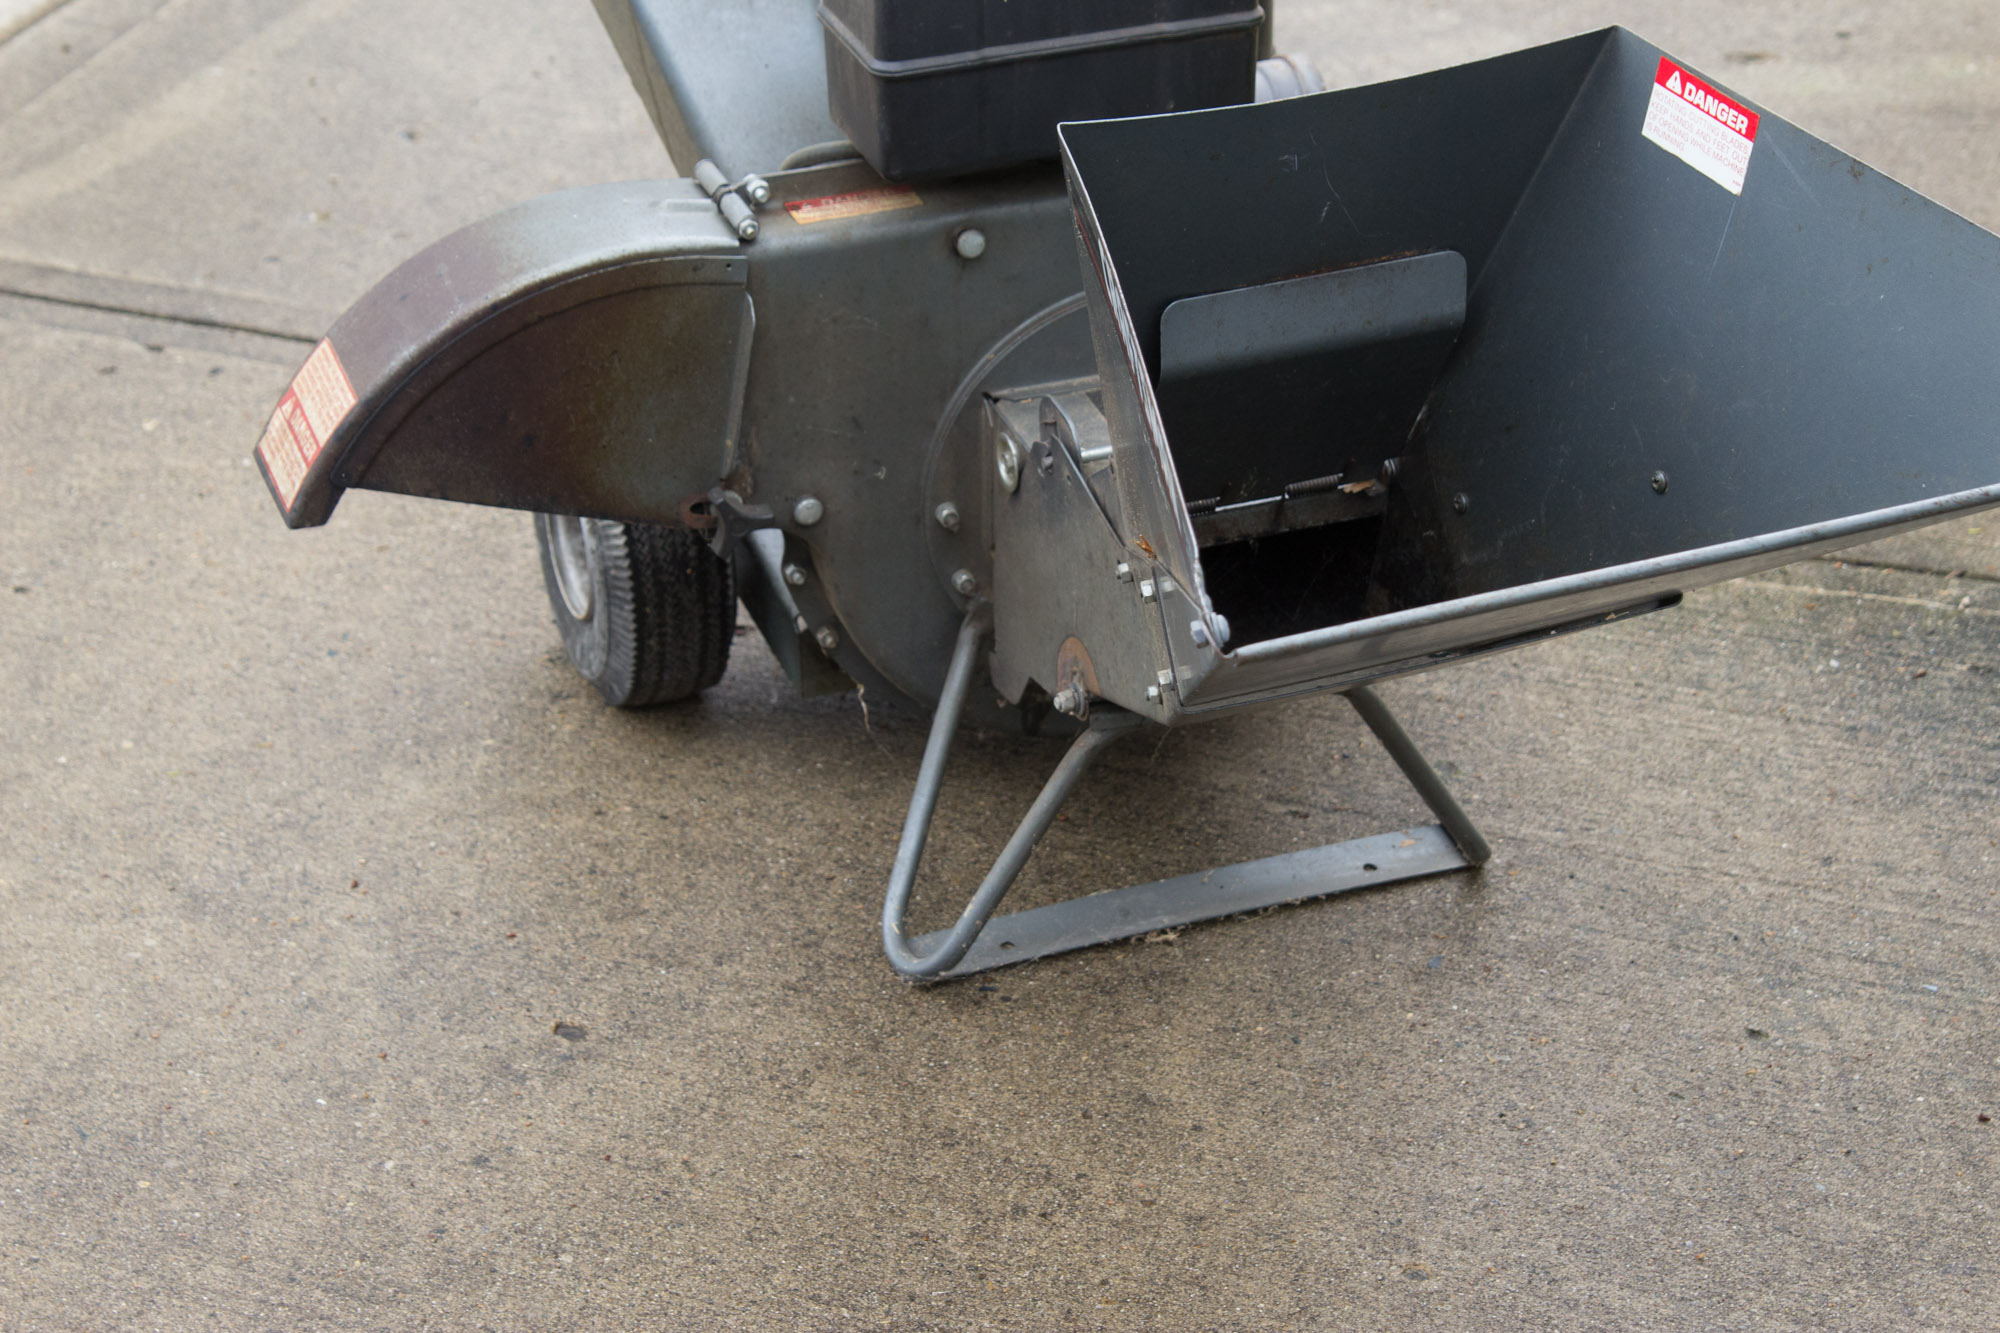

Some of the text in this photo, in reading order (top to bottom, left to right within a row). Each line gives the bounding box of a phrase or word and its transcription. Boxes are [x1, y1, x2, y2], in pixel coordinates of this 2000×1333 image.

[1645, 121, 1653, 131] IS
[1650, 100, 1748, 166] KEEP HANDS AND FEET OUT
[1654, 90, 1686, 116] ROTATING
[1689, 112, 1720, 137] CUTTING
[1684, 82, 1748, 134] DANGER
[1648, 111, 1744, 177] OF OPENING WHILE MACHINE
